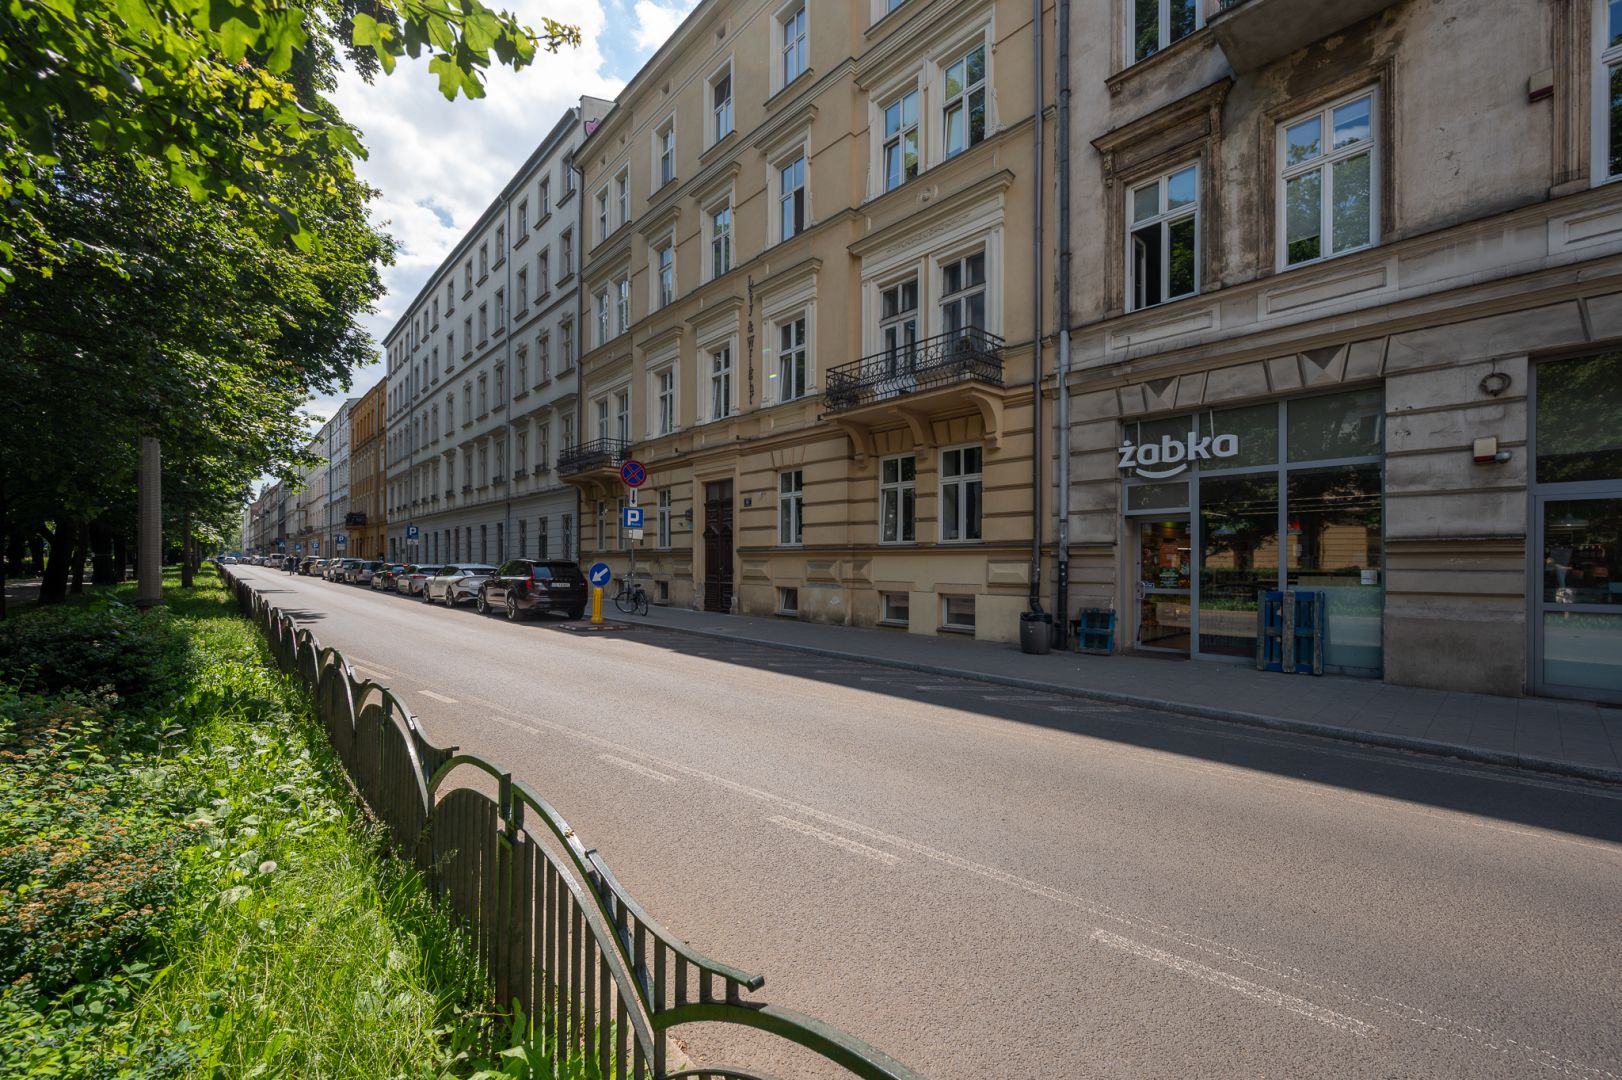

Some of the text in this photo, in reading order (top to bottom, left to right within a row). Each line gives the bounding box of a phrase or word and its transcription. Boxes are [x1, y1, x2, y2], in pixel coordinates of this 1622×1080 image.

[1118, 432, 1238, 468] żabka
[628, 510, 639, 526] P
[409, 527, 417, 536] P
